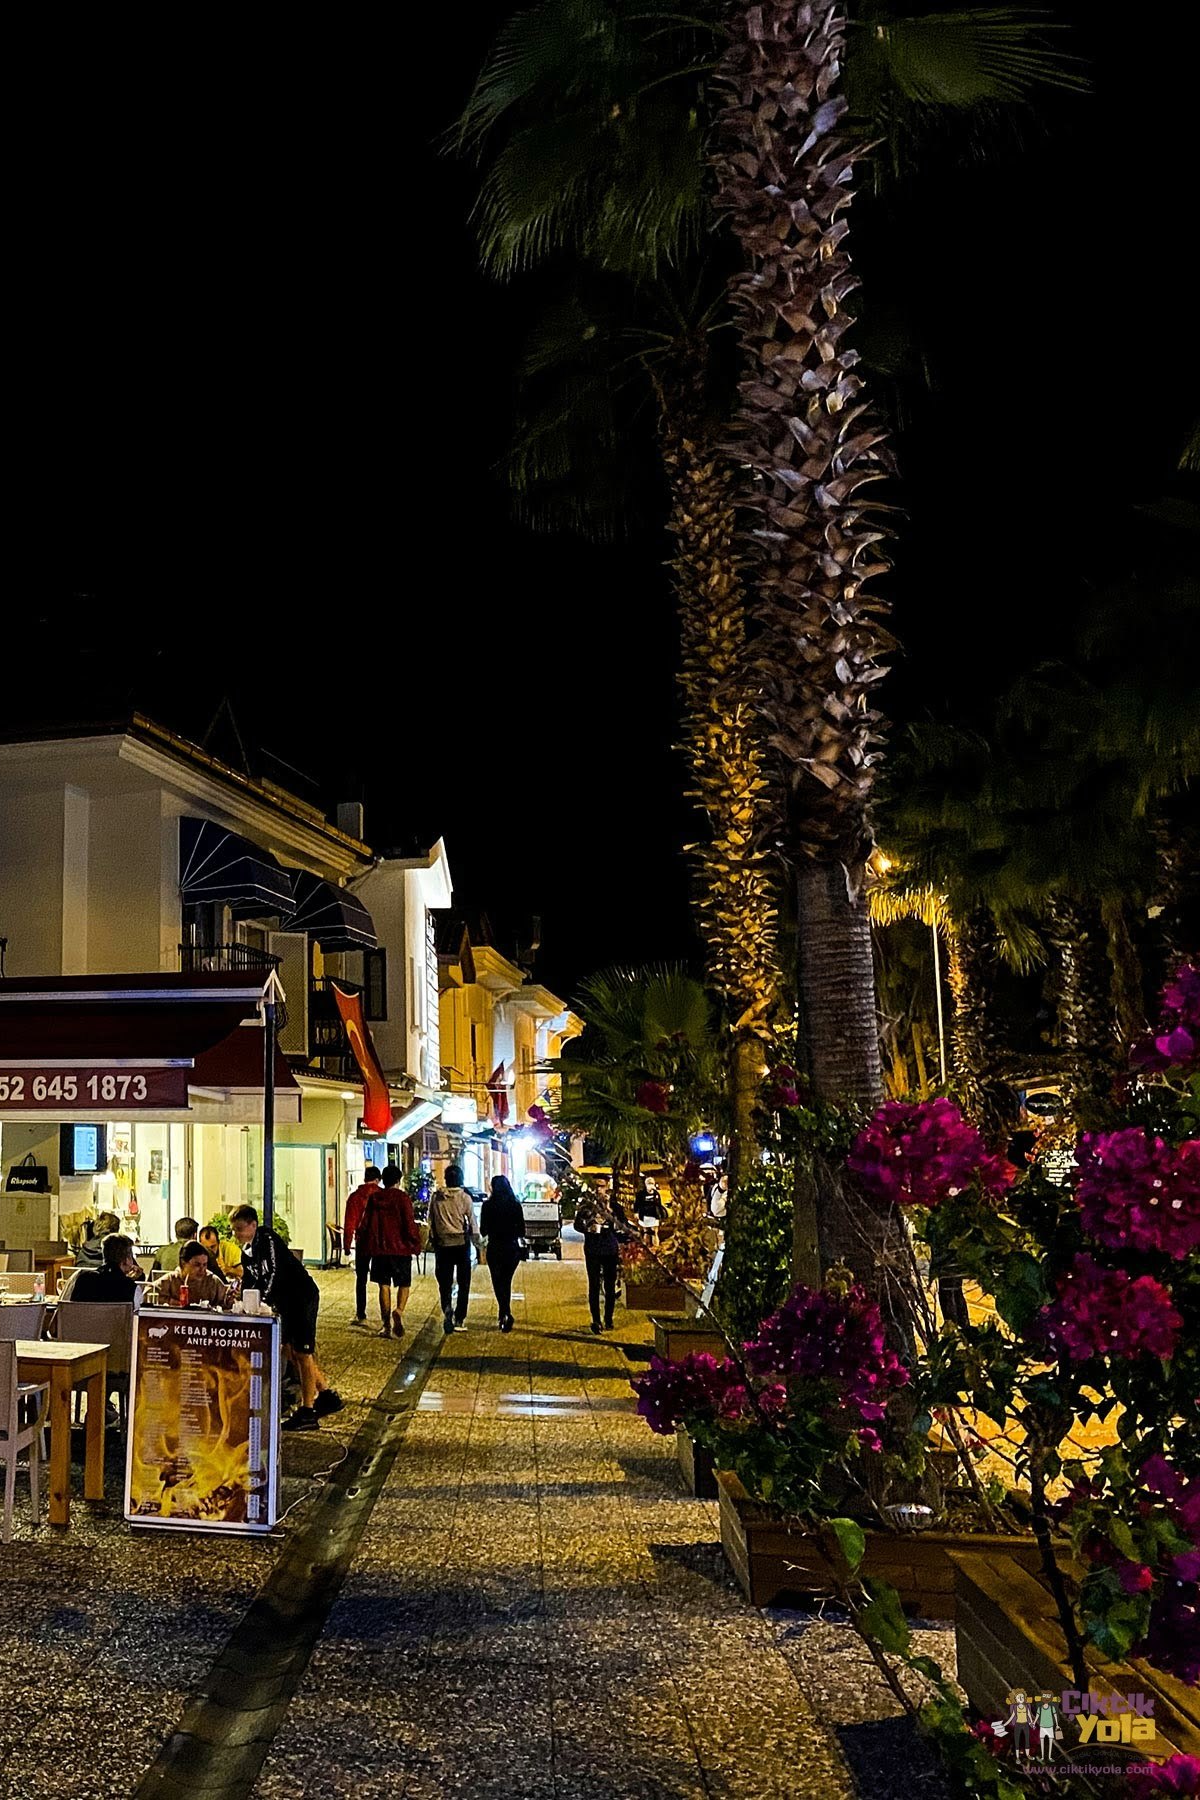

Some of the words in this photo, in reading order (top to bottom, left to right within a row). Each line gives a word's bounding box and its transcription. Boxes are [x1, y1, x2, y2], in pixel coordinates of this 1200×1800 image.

[32, 1075, 77, 1101] 645
[86, 1074, 148, 1101] 1873
[174, 1325, 207, 1335] KEBAB
[211, 1328, 262, 1339] HOSPITAL
[187, 1337, 213, 1346] ANTEP
[215, 1339, 250, 1349] SOFRASI
